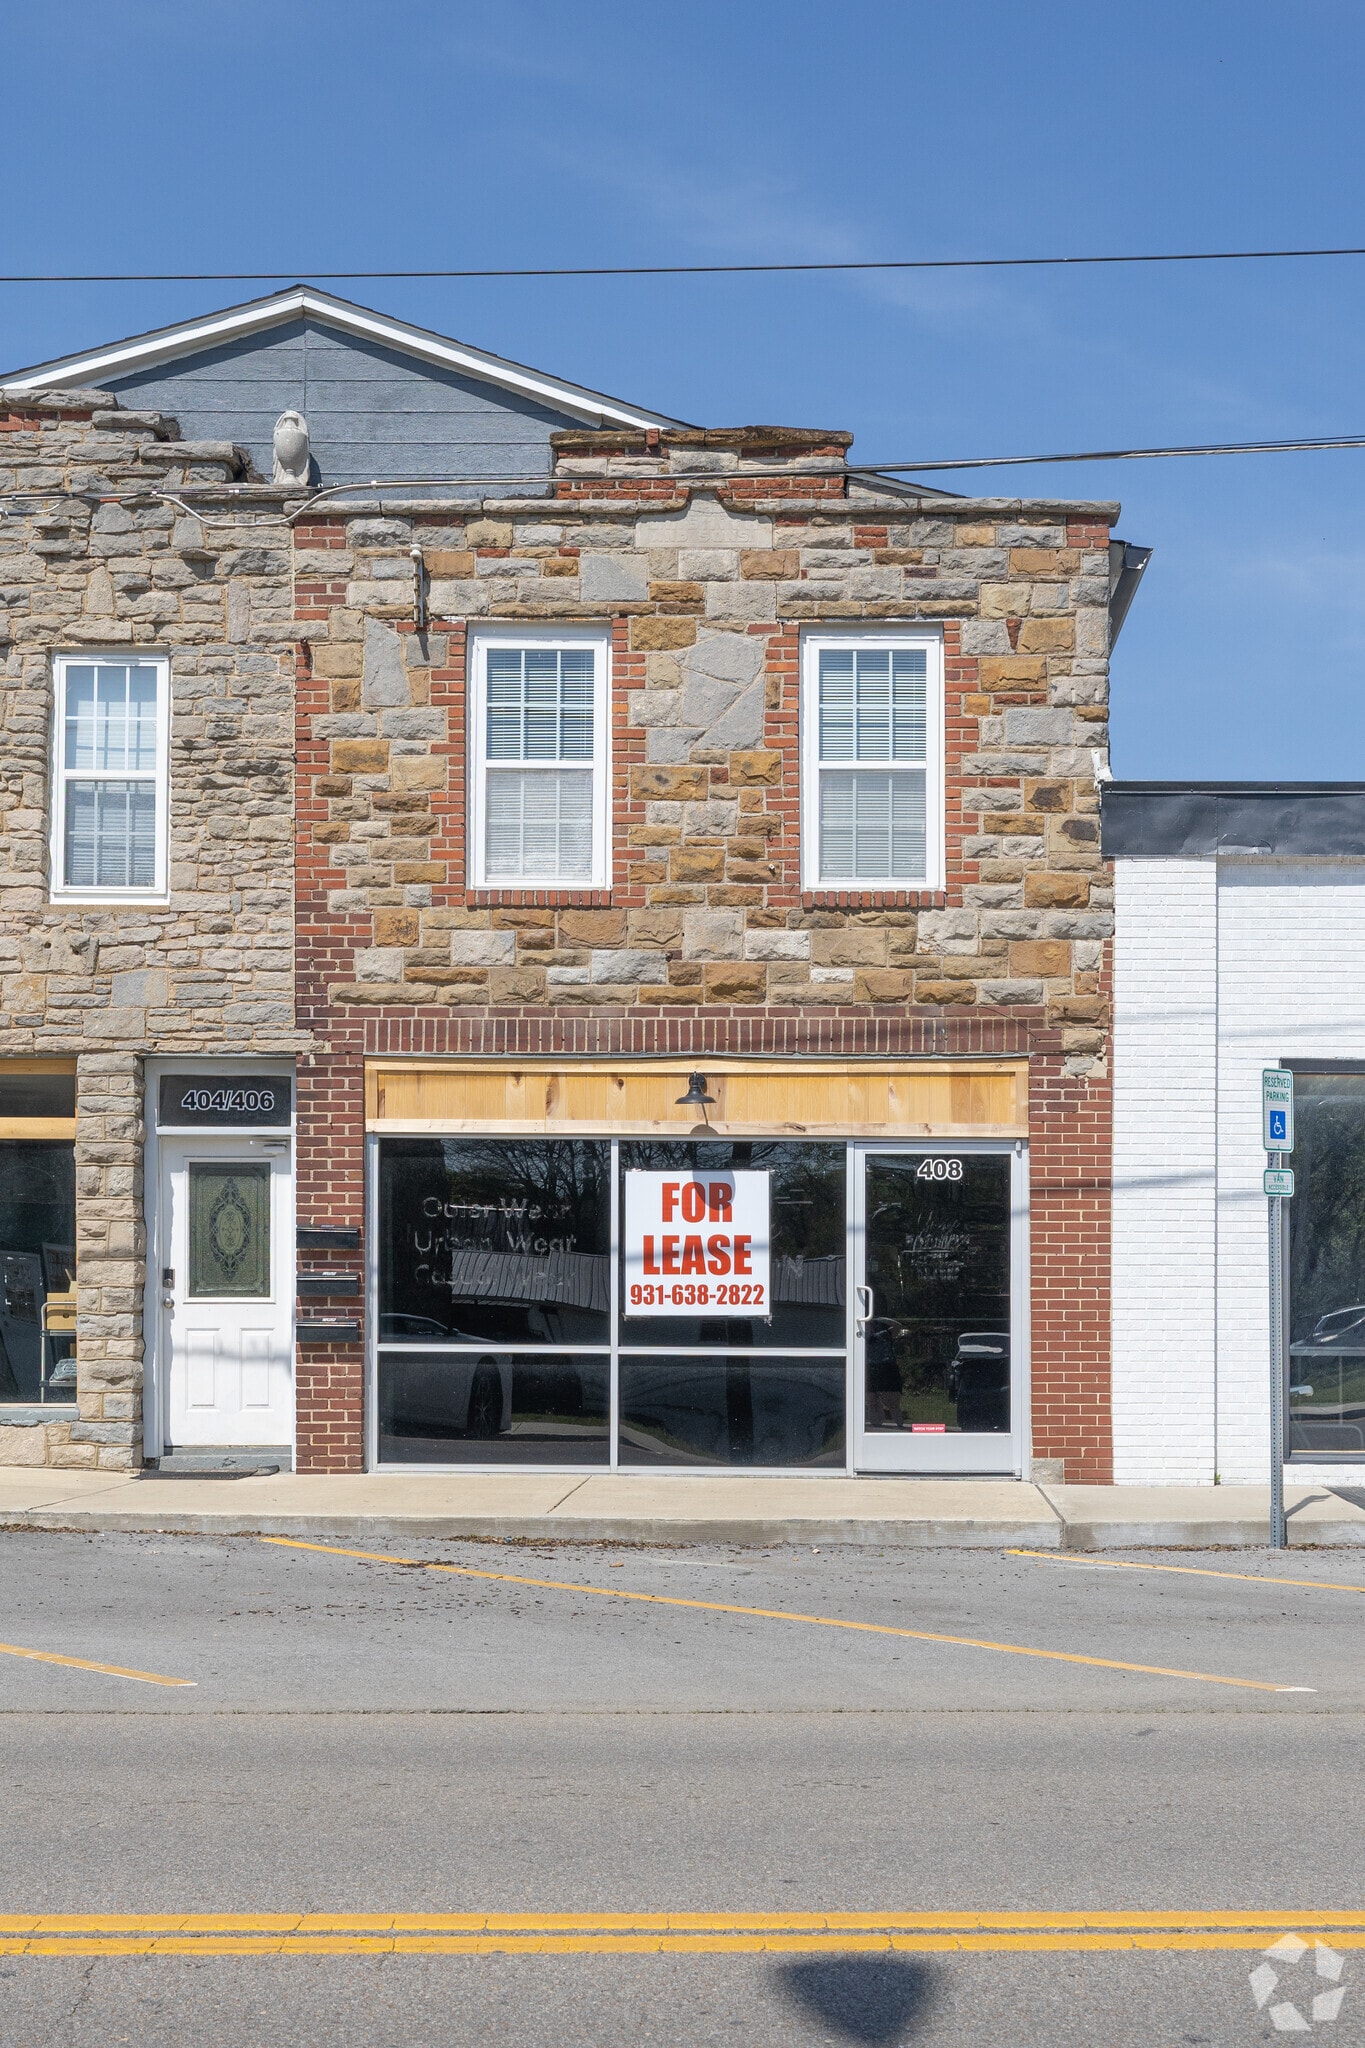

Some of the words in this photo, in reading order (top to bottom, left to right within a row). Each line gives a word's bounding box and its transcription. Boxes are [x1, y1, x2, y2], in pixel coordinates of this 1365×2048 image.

[1264, 1076, 1290, 1089] RESERVED
[181, 1090, 275, 1111] 404/406
[1266, 1090, 1289, 1102] PARKING
[917, 1159, 963, 1180] 408
[1273, 1174, 1284, 1183] VAN
[498, 1196, 573, 1219] Wear
[662, 1181, 733, 1223] FOR
[506, 1230, 577, 1254] Wear
[643, 1234, 753, 1276] LEASE
[630, 1284, 765, 1305] 931-638-2822
